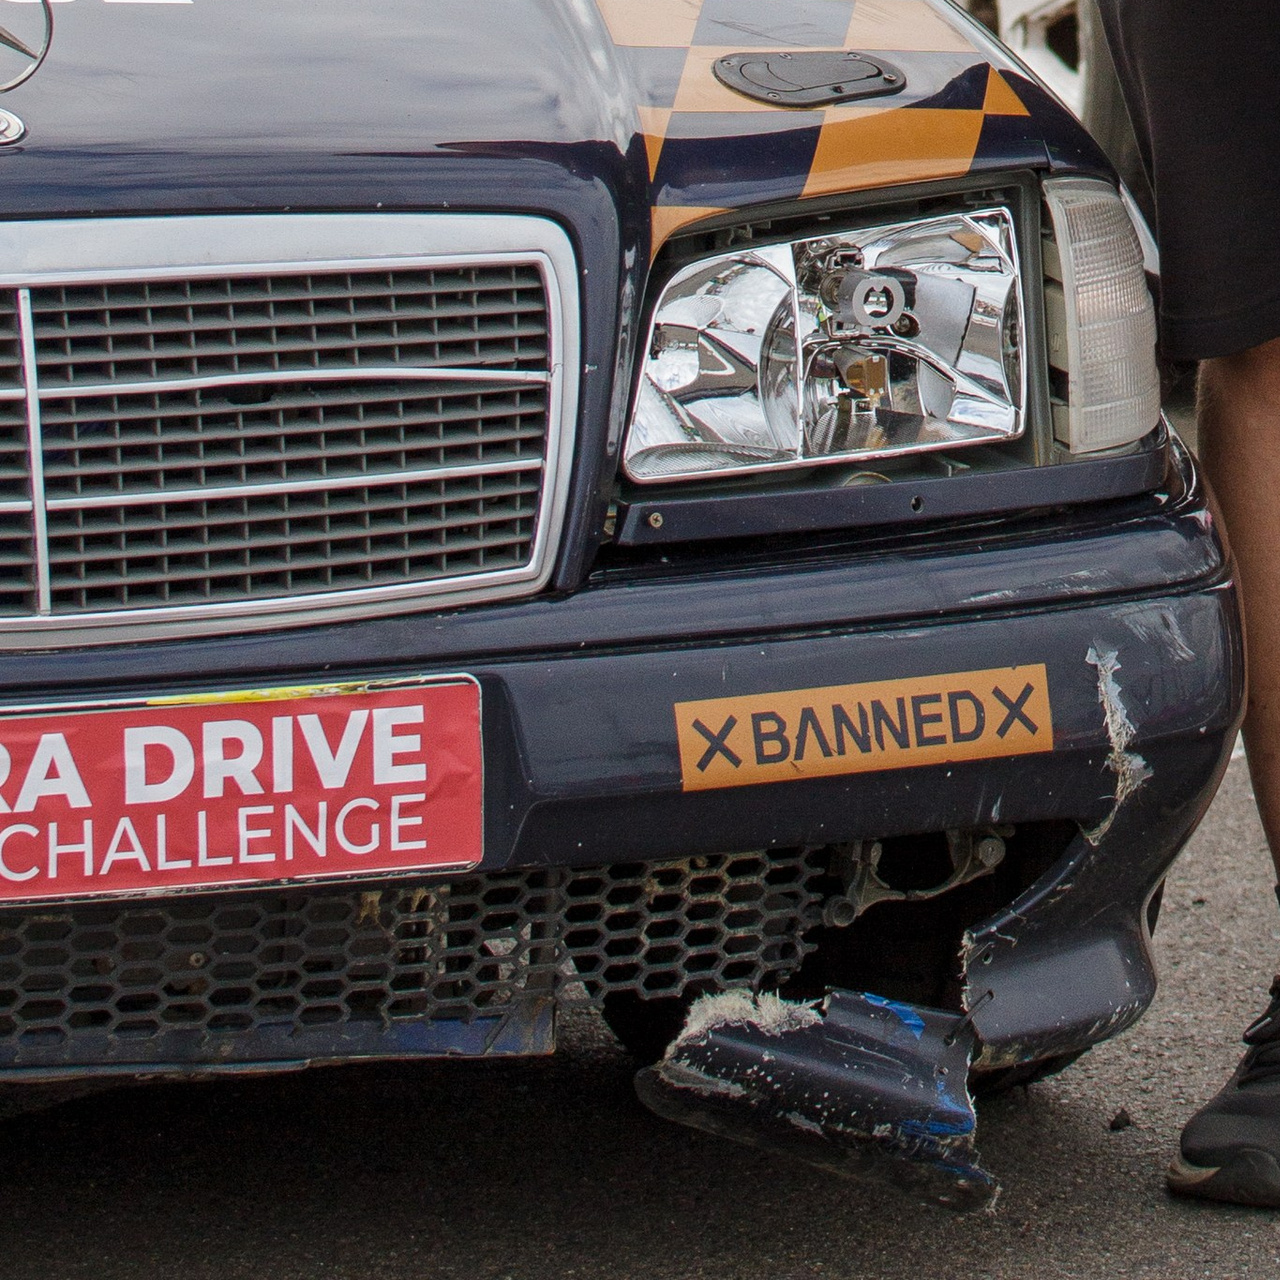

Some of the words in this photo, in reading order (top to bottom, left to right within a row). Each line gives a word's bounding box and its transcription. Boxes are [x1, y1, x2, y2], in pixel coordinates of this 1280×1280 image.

[0, 732, 92, 813] A
[124, 704, 428, 805] DRIVE
[0, 792, 428, 882] CHALLENGE
